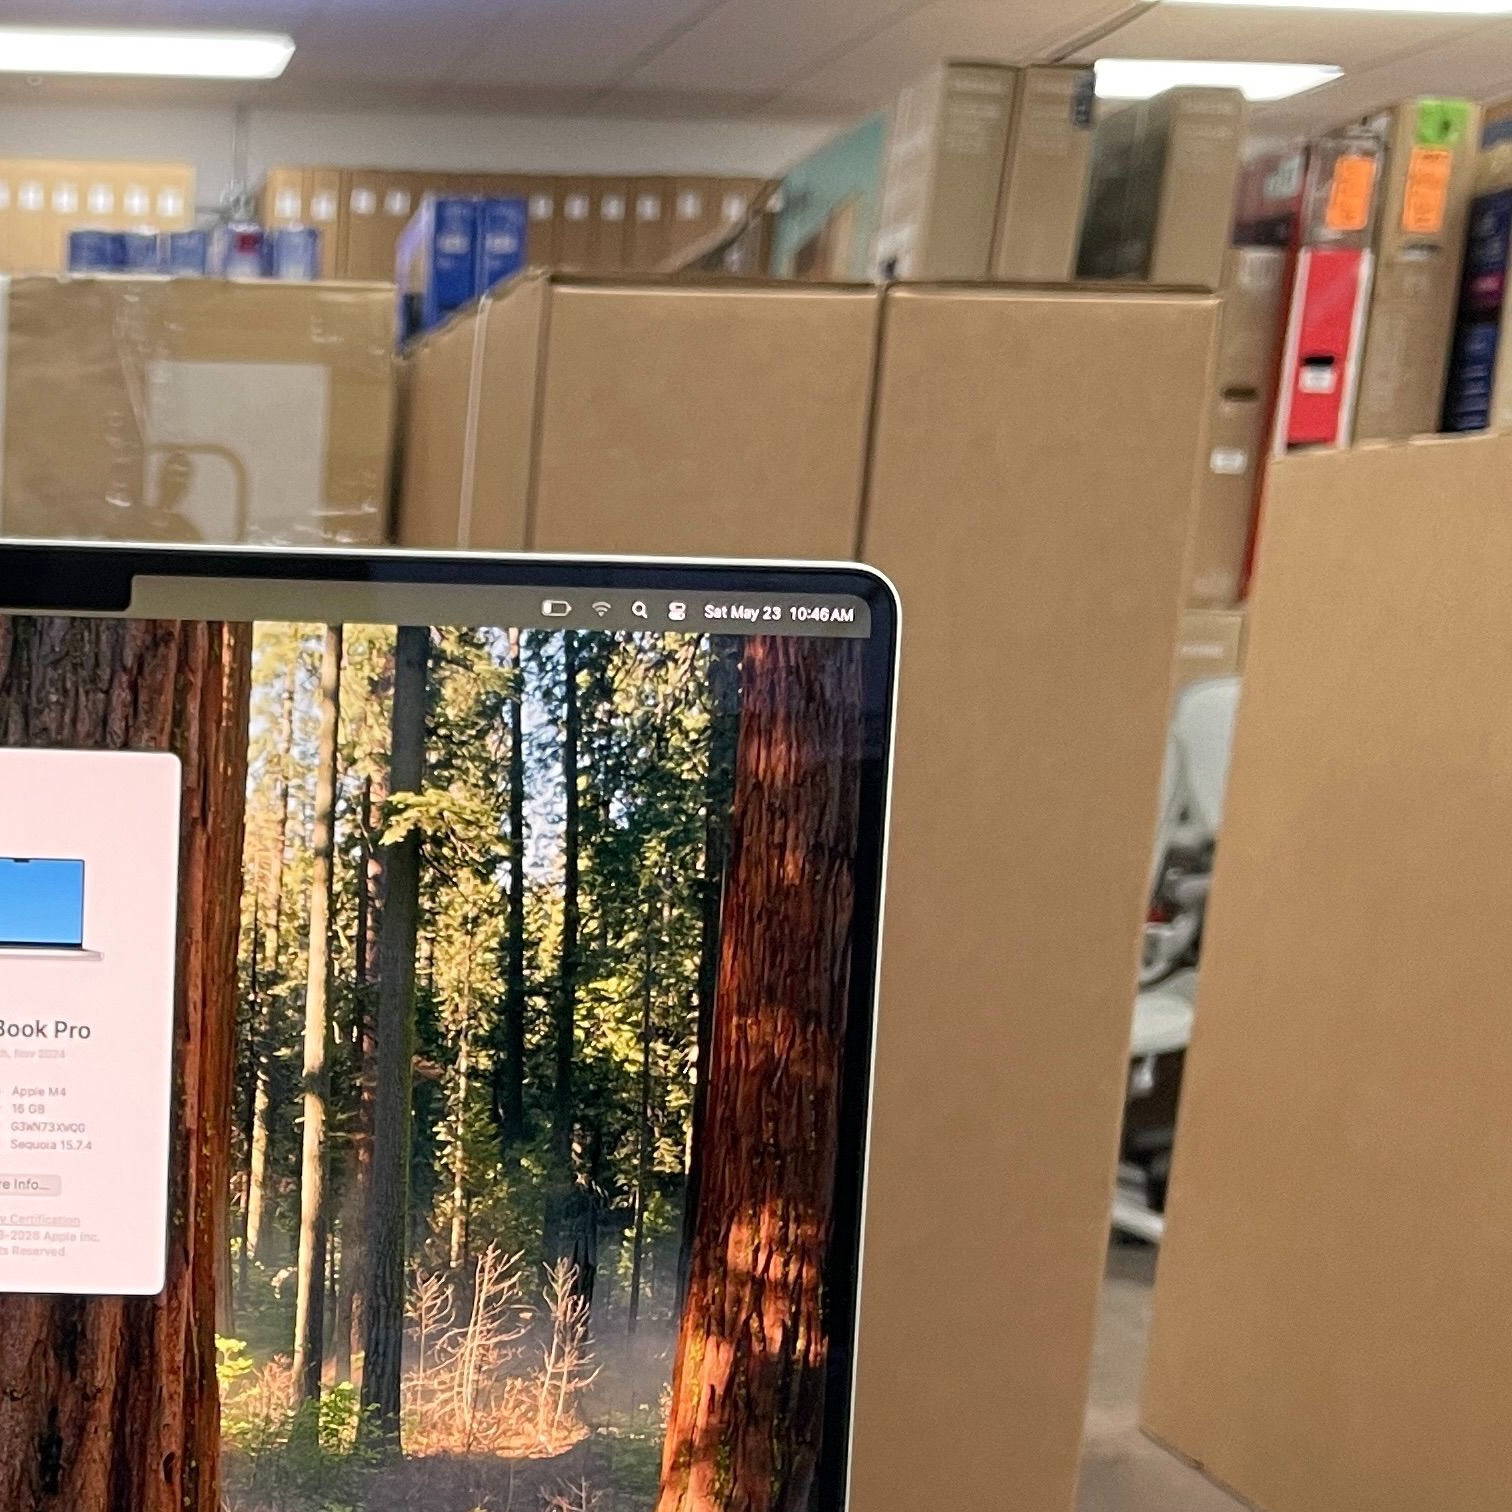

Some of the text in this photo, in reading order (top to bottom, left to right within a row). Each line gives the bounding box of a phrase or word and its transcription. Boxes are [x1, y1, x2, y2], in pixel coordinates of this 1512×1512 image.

[704, 604, 855, 622] Sat May 23 10:46 AM
[54, 1020, 92, 1039] Pro
[11, 1086, 45, 1098] Apple
[48, 1087, 66, 1097] M4
[12, 1103, 25, 1114] 16
[28, 1104, 45, 1114] GB
[10, 1139, 57, 1151] Sequoia
[60, 1139, 92, 1151] 15.7.4
[10, 1213, 81, 1227] Certification
[43, 1231, 77, 1243] Apple
